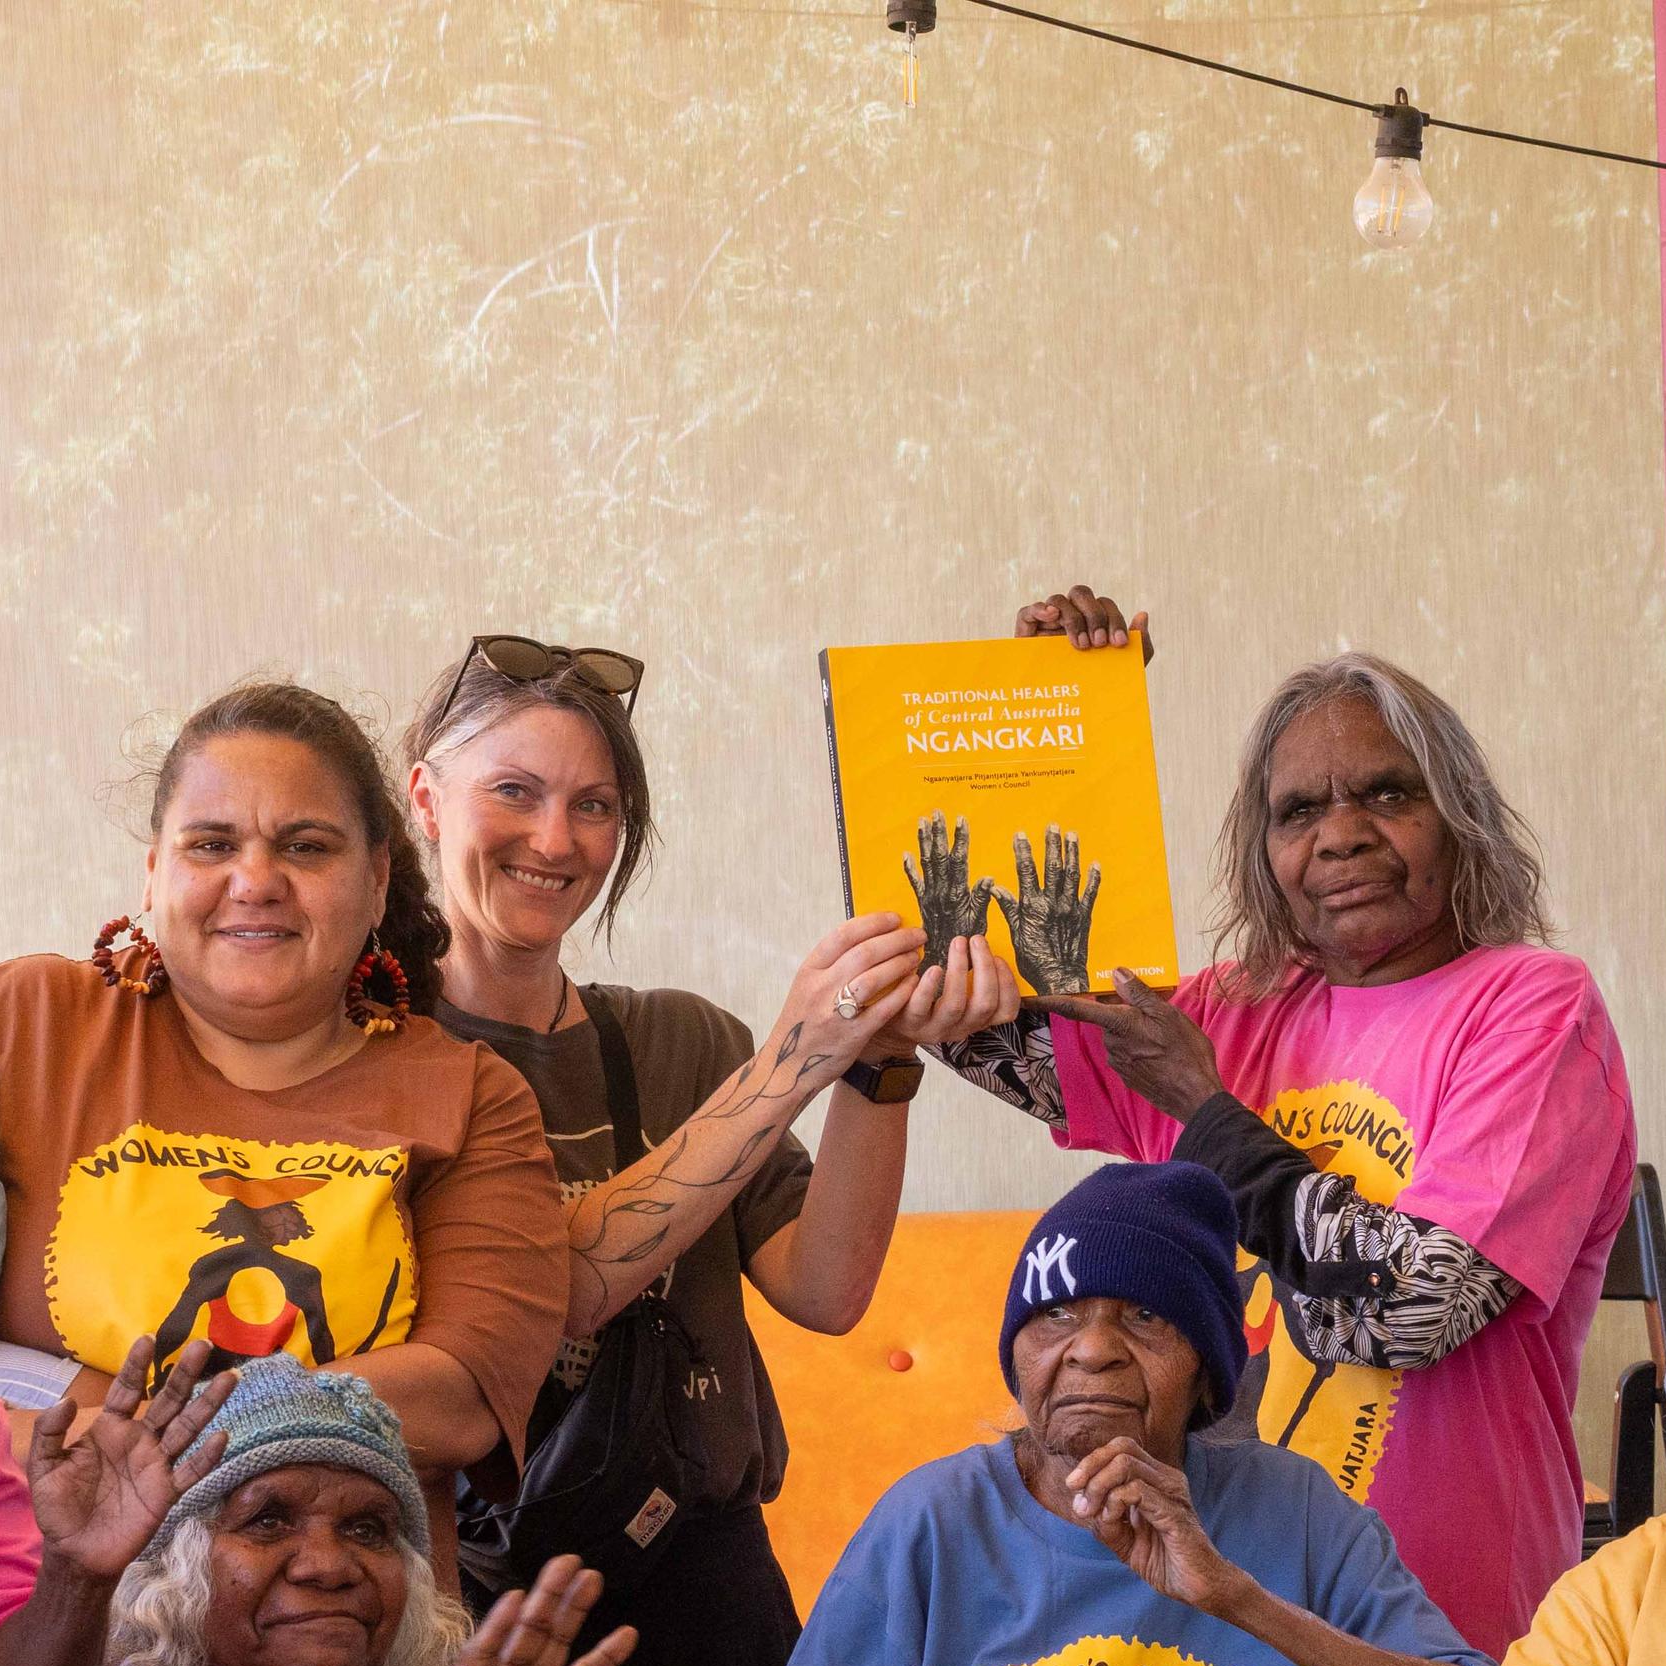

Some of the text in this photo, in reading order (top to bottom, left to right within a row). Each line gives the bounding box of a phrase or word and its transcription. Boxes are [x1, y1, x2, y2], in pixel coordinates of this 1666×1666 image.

[902, 684, 1080, 705] TRADITIONAL HEALERS
[904, 702, 1081, 729] of Central Australia
[80, 1139, 405, 1185] WOMEN'S COUNCI
[1319, 1101, 1413, 1179] COUNCIL
[1022, 1233, 1078, 1305] NY
